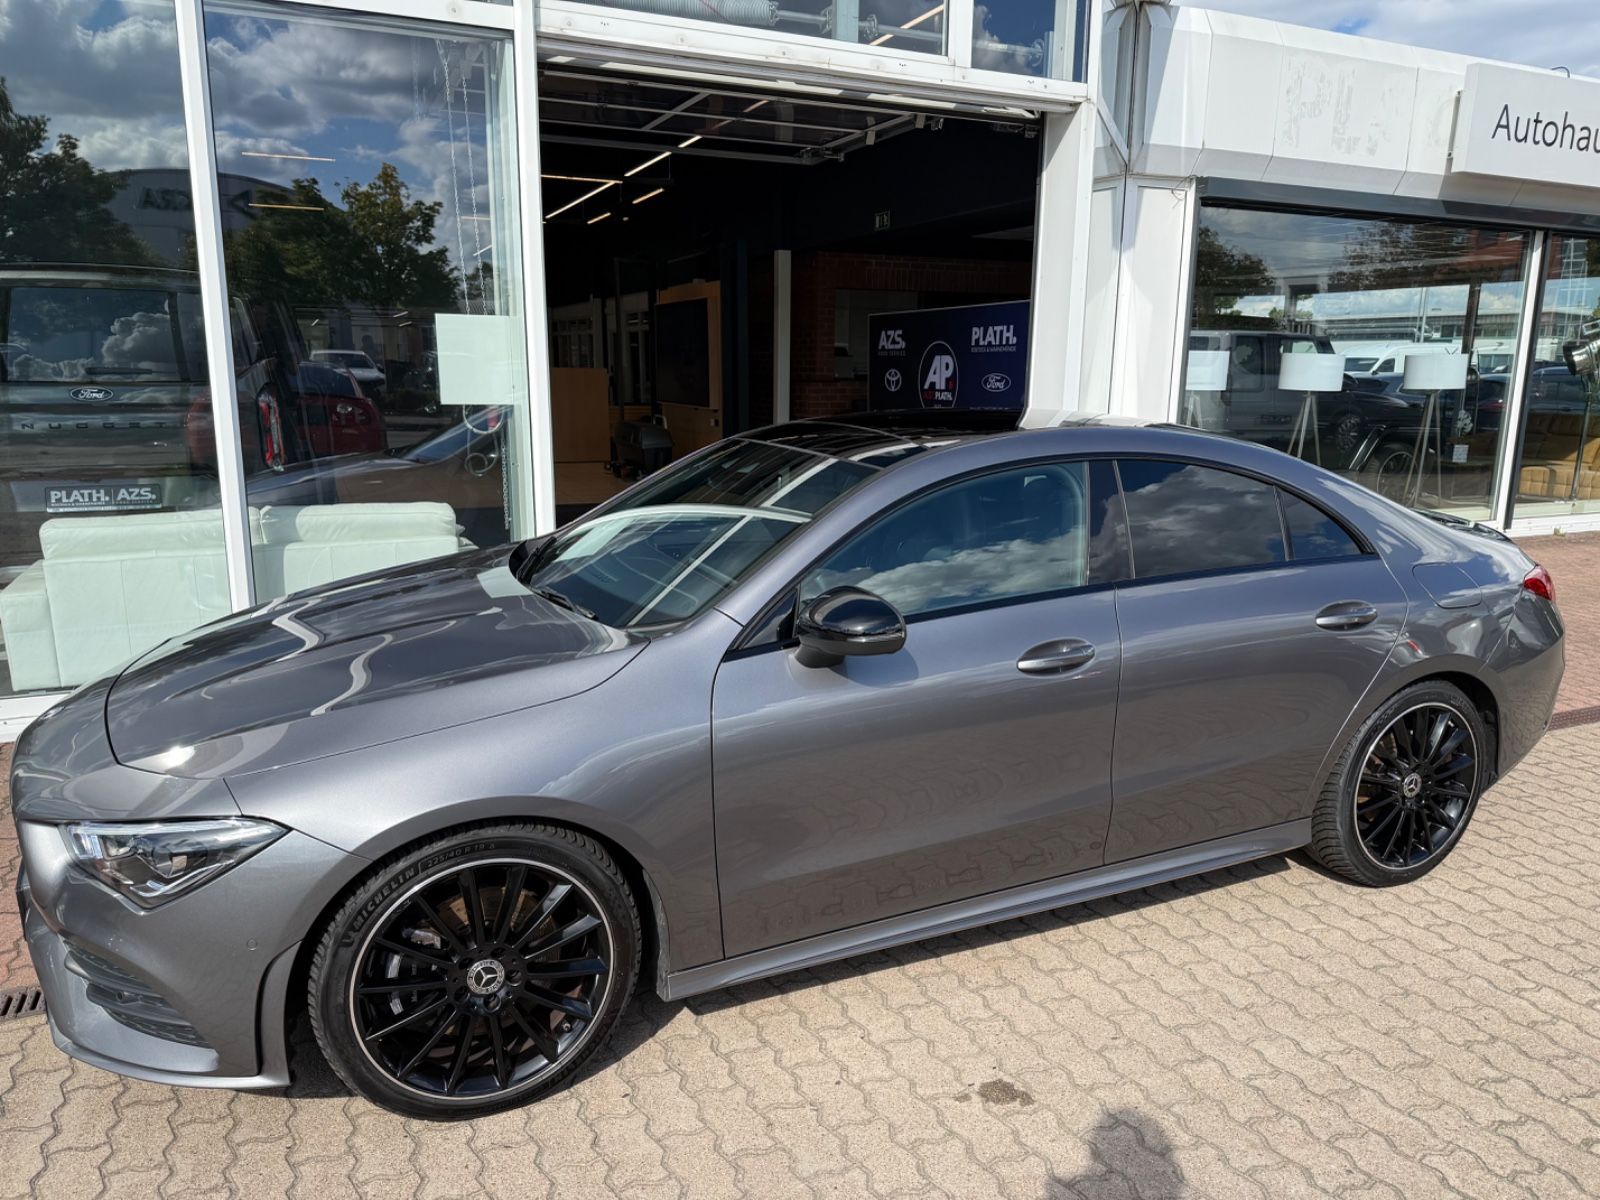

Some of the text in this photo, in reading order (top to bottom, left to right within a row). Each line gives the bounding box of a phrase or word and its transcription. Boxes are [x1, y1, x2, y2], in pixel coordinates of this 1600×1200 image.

[971, 325, 1017, 346] PLATH.
[923, 355, 954, 390] AP
[21, 422, 167, 430] NUGGET
[50, 487, 157, 503] PLATH. AZS.
[352, 867, 416, 931] MICHELIN
